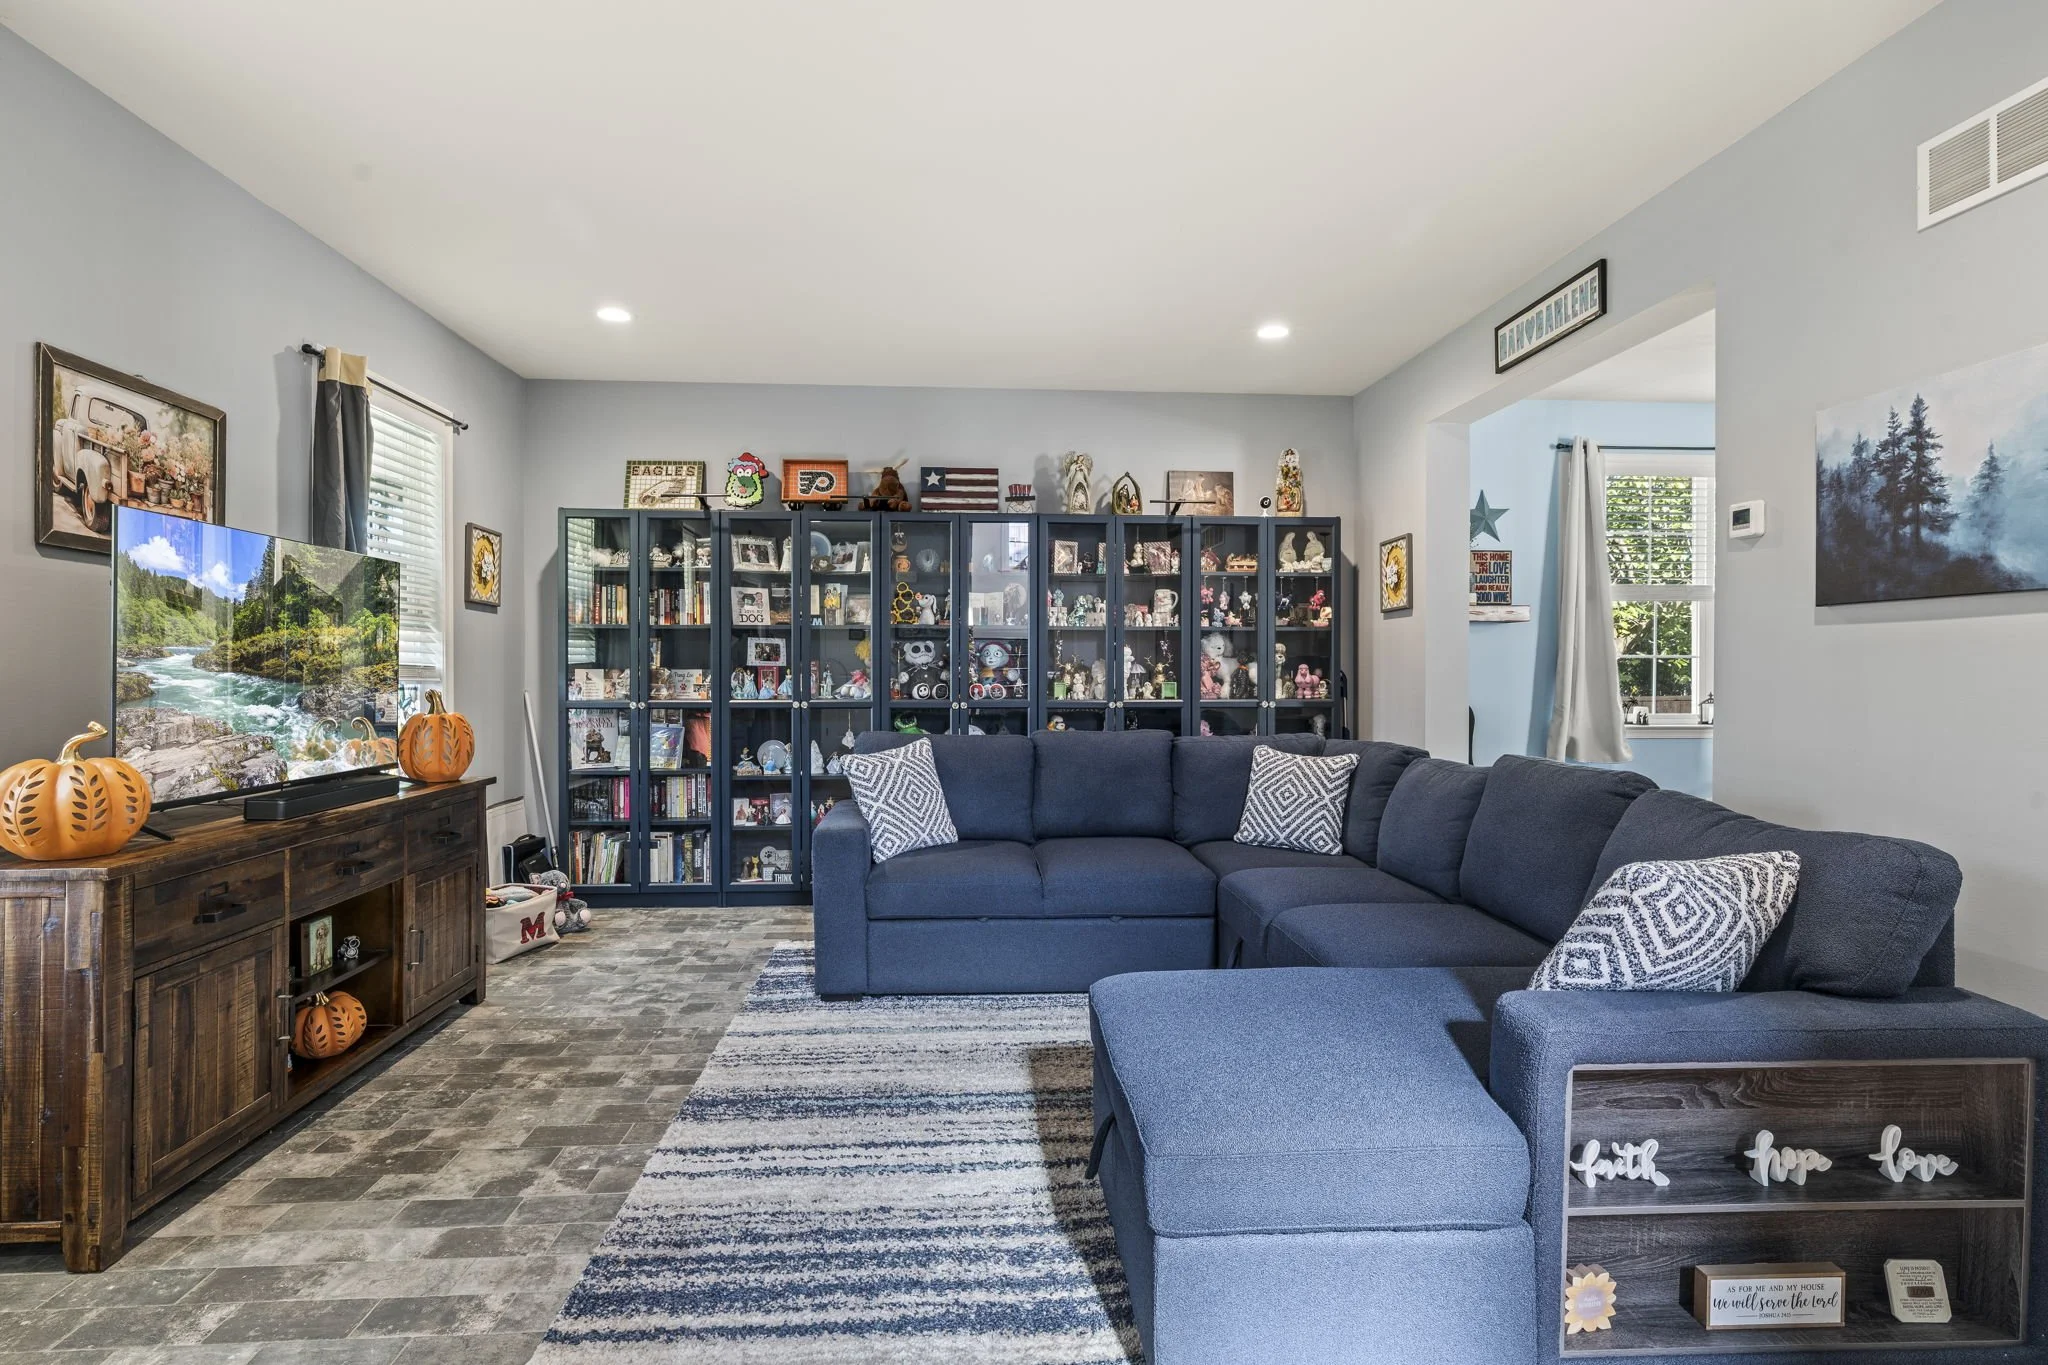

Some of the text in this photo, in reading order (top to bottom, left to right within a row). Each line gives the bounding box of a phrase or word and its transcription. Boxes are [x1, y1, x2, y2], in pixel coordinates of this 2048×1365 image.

[631, 465, 696, 477] EAGLES
[1472, 552, 1510, 561] THIS HOME
[1488, 561, 1510, 575] LOVE
[1475, 574, 1510, 584] LAUGHTER
[1493, 592, 1510, 602] WINE
[739, 613, 765, 623] DOG
[520, 911, 546, 944] M
[1744, 1130, 1832, 1186] hope
[1868, 1124, 1959, 1182] love
[1569, 1139, 1670, 1188] faith
[1738, 1285, 1753, 1293] FOR
[1768, 1284, 1784, 1292] AND
[1801, 1283, 1825, 1291] HOUSE
[1731, 1291, 1759, 1310] will
[1759, 1296, 1790, 1311] serve
[1790, 1291, 1809, 1310] the
[1811, 1291, 1839, 1308] Lord
